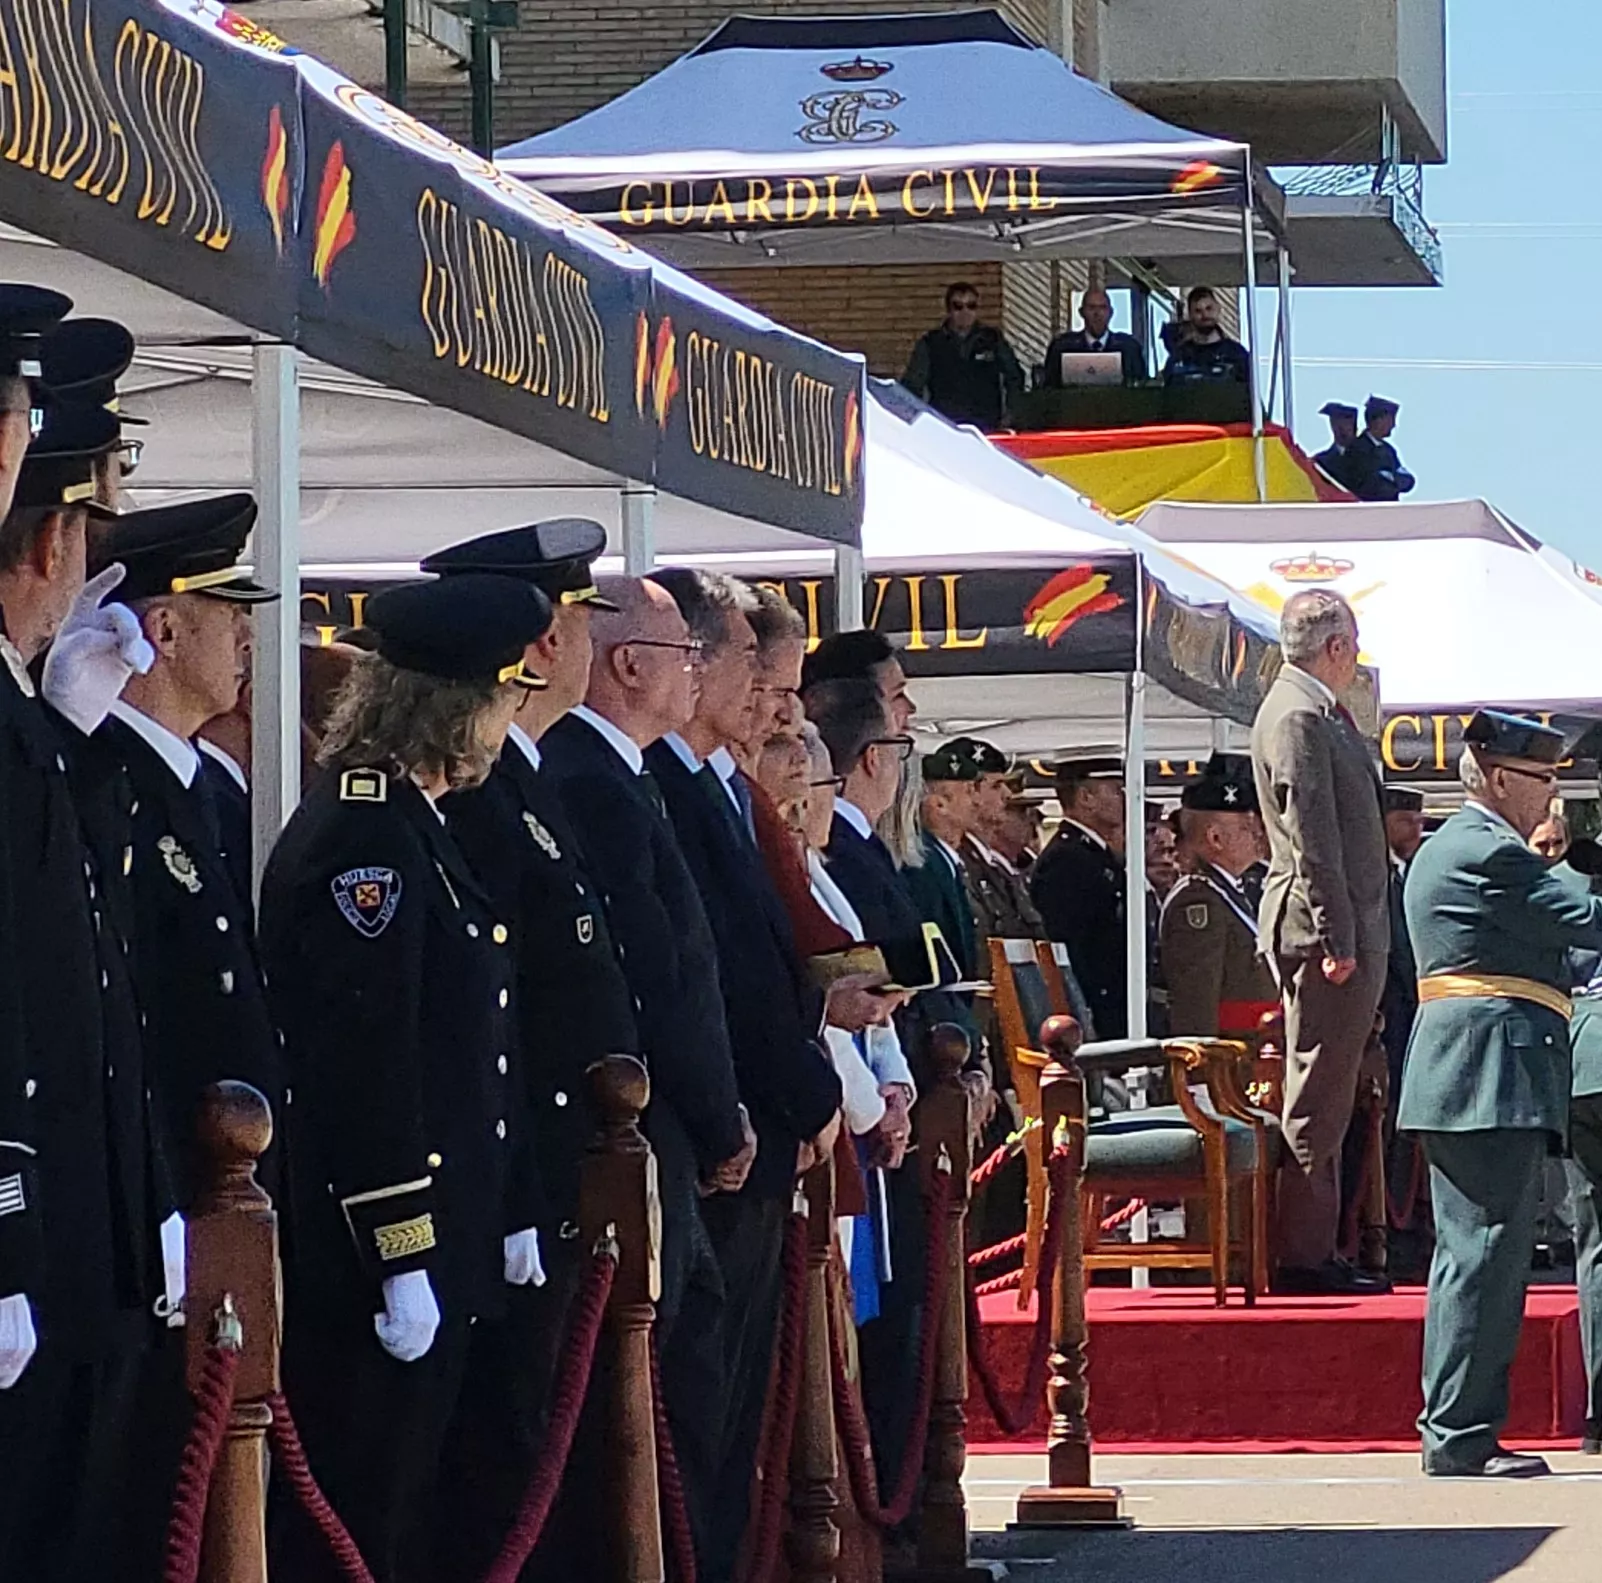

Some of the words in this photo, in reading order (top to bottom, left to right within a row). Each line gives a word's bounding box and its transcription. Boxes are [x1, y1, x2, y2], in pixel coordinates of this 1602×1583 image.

[115, 19, 232, 250] CIVIL
[619, 172, 881, 226] GUARDIA
[902, 166, 1057, 217] CIVIL
[418, 188, 551, 397] GUARDIA
[543, 251, 609, 422] CIVIL
[687, 331, 790, 481] GUARDIA
[790, 371, 841, 496] CIVIL
